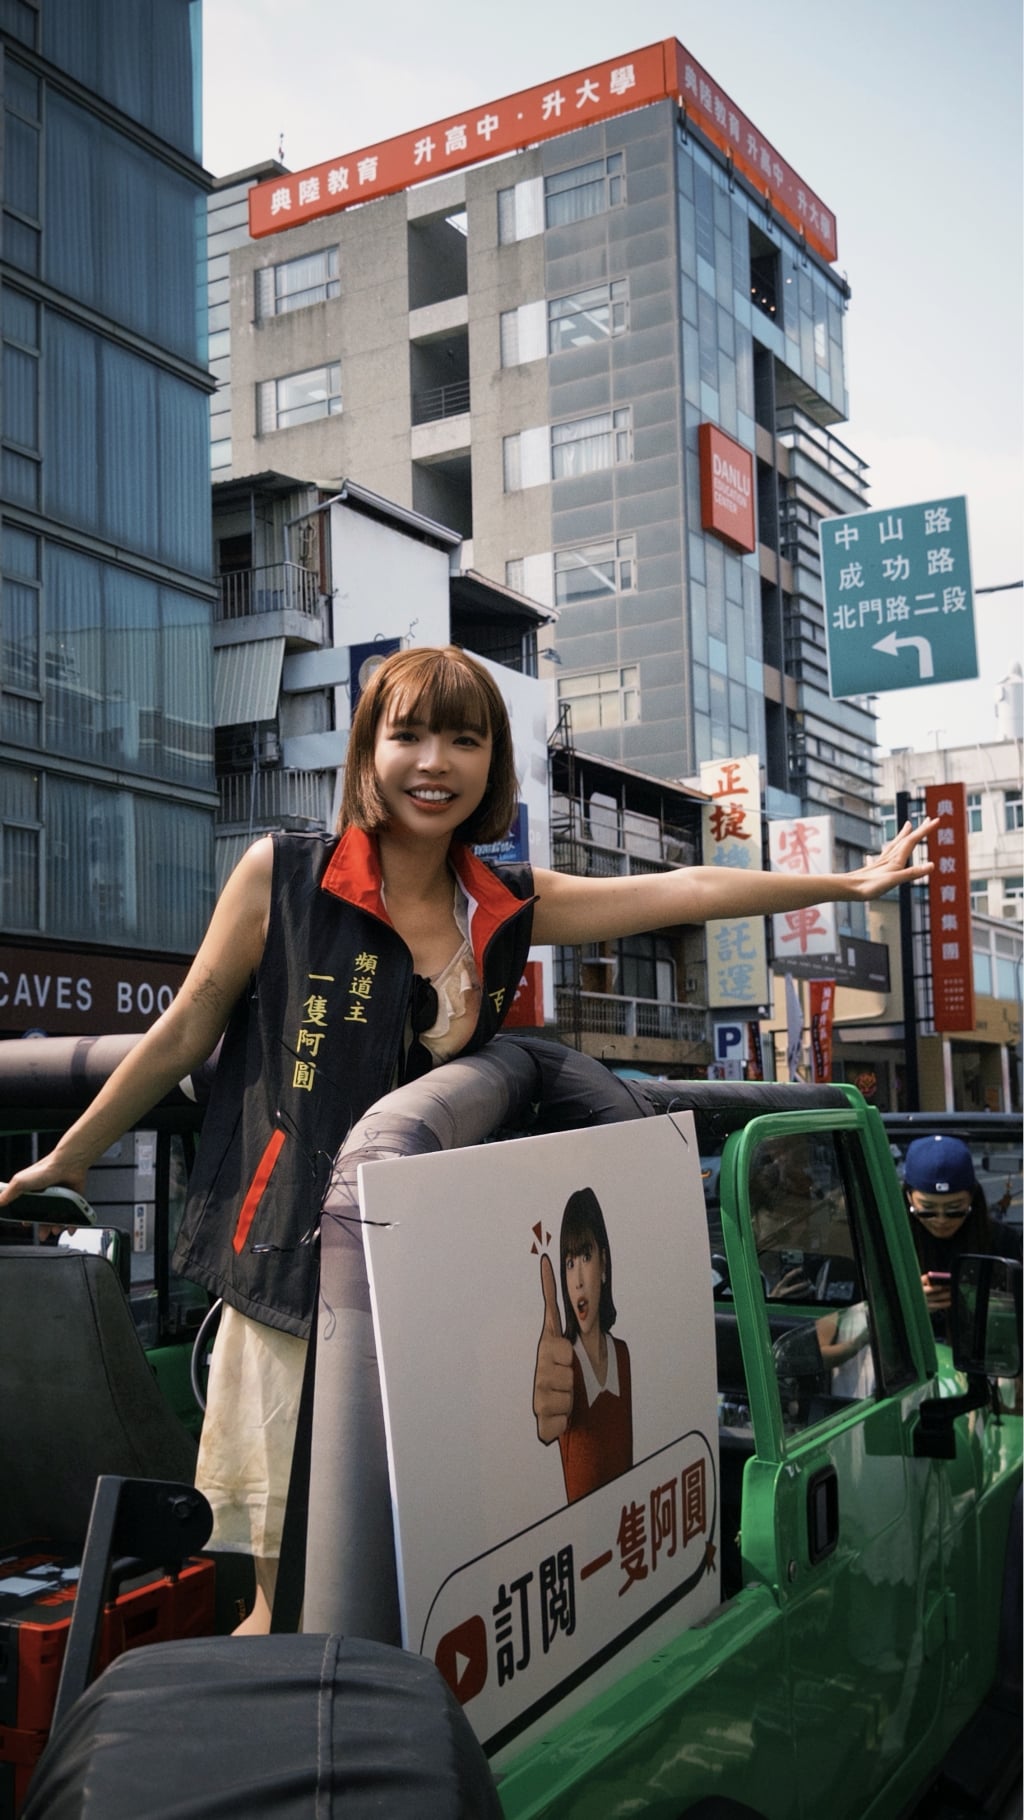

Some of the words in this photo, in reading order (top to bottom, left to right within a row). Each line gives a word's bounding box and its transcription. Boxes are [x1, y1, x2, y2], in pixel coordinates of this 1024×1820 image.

[271, 156, 379, 216] 典陸教育
[713, 453, 750, 497] DANLU
[834, 507, 952, 551] 中山路
[838, 548, 955, 591] 成功路
[832, 587, 967, 630] 北門路二段
[344, 951, 378, 1024] 頻道主
[292, 973, 335, 1092] 一隻阿圓
[718, 1027, 742, 1058] P
